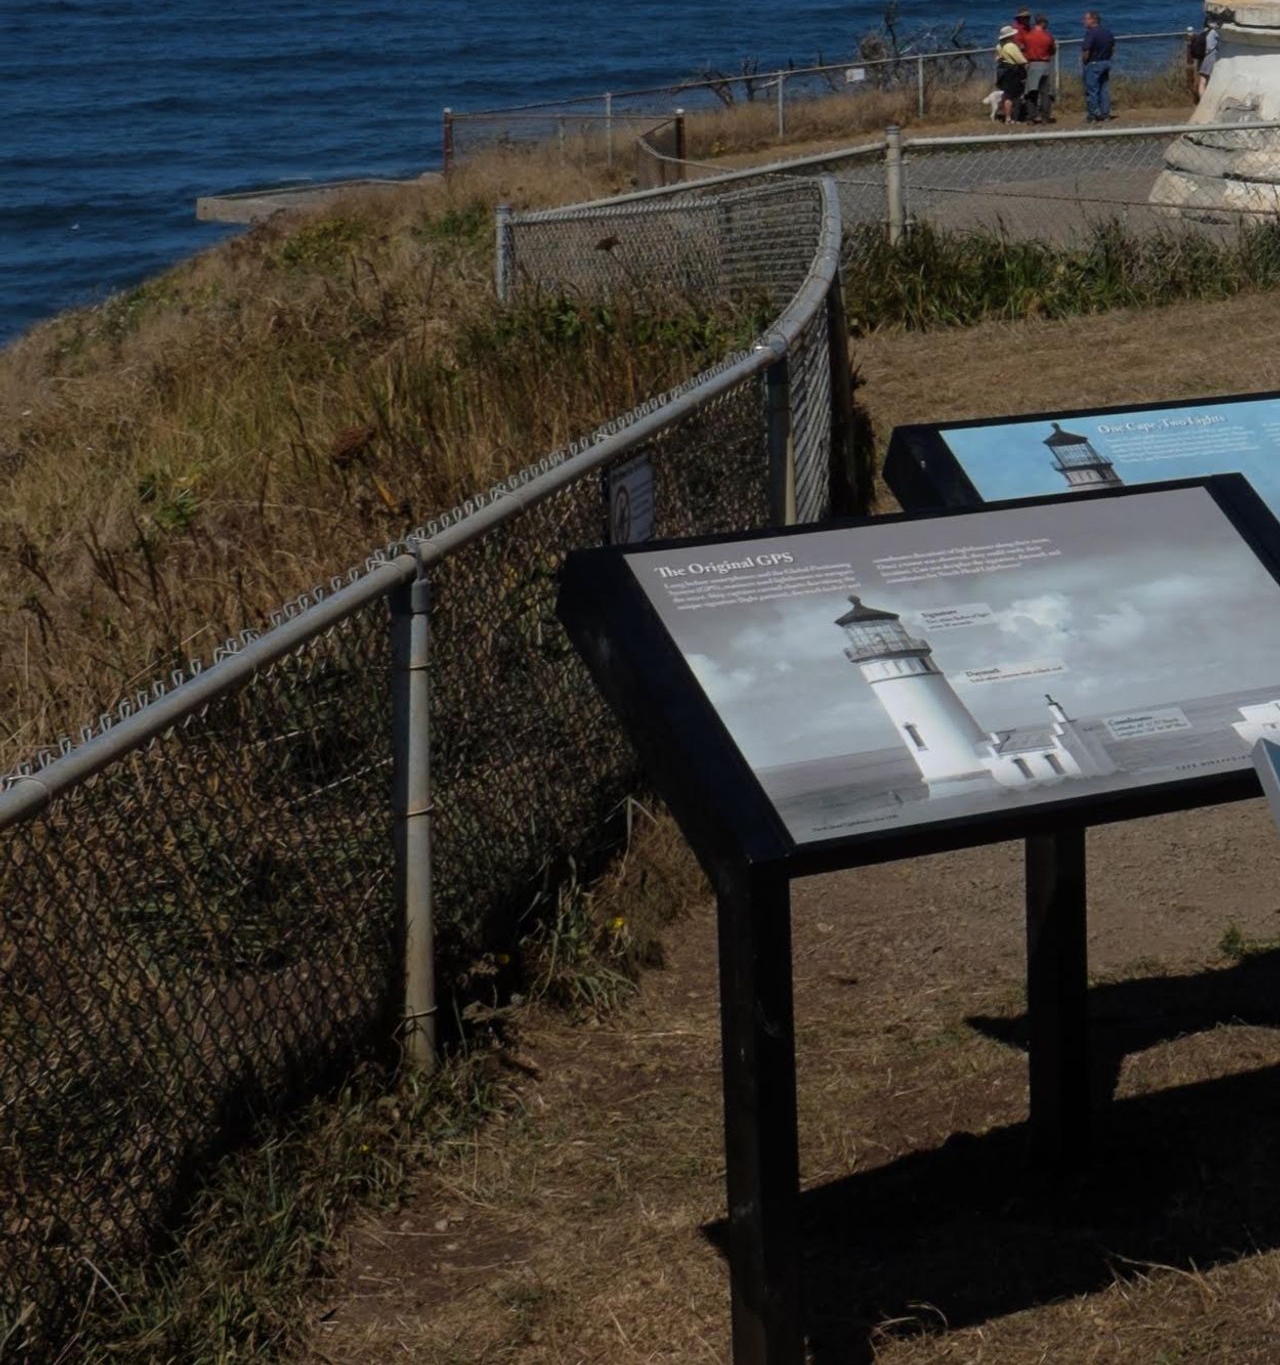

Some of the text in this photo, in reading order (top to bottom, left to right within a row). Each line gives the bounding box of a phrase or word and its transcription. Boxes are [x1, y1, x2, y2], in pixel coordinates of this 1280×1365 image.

[1098, 424, 1125, 433] One
[654, 552, 794, 578] The Original GPS
